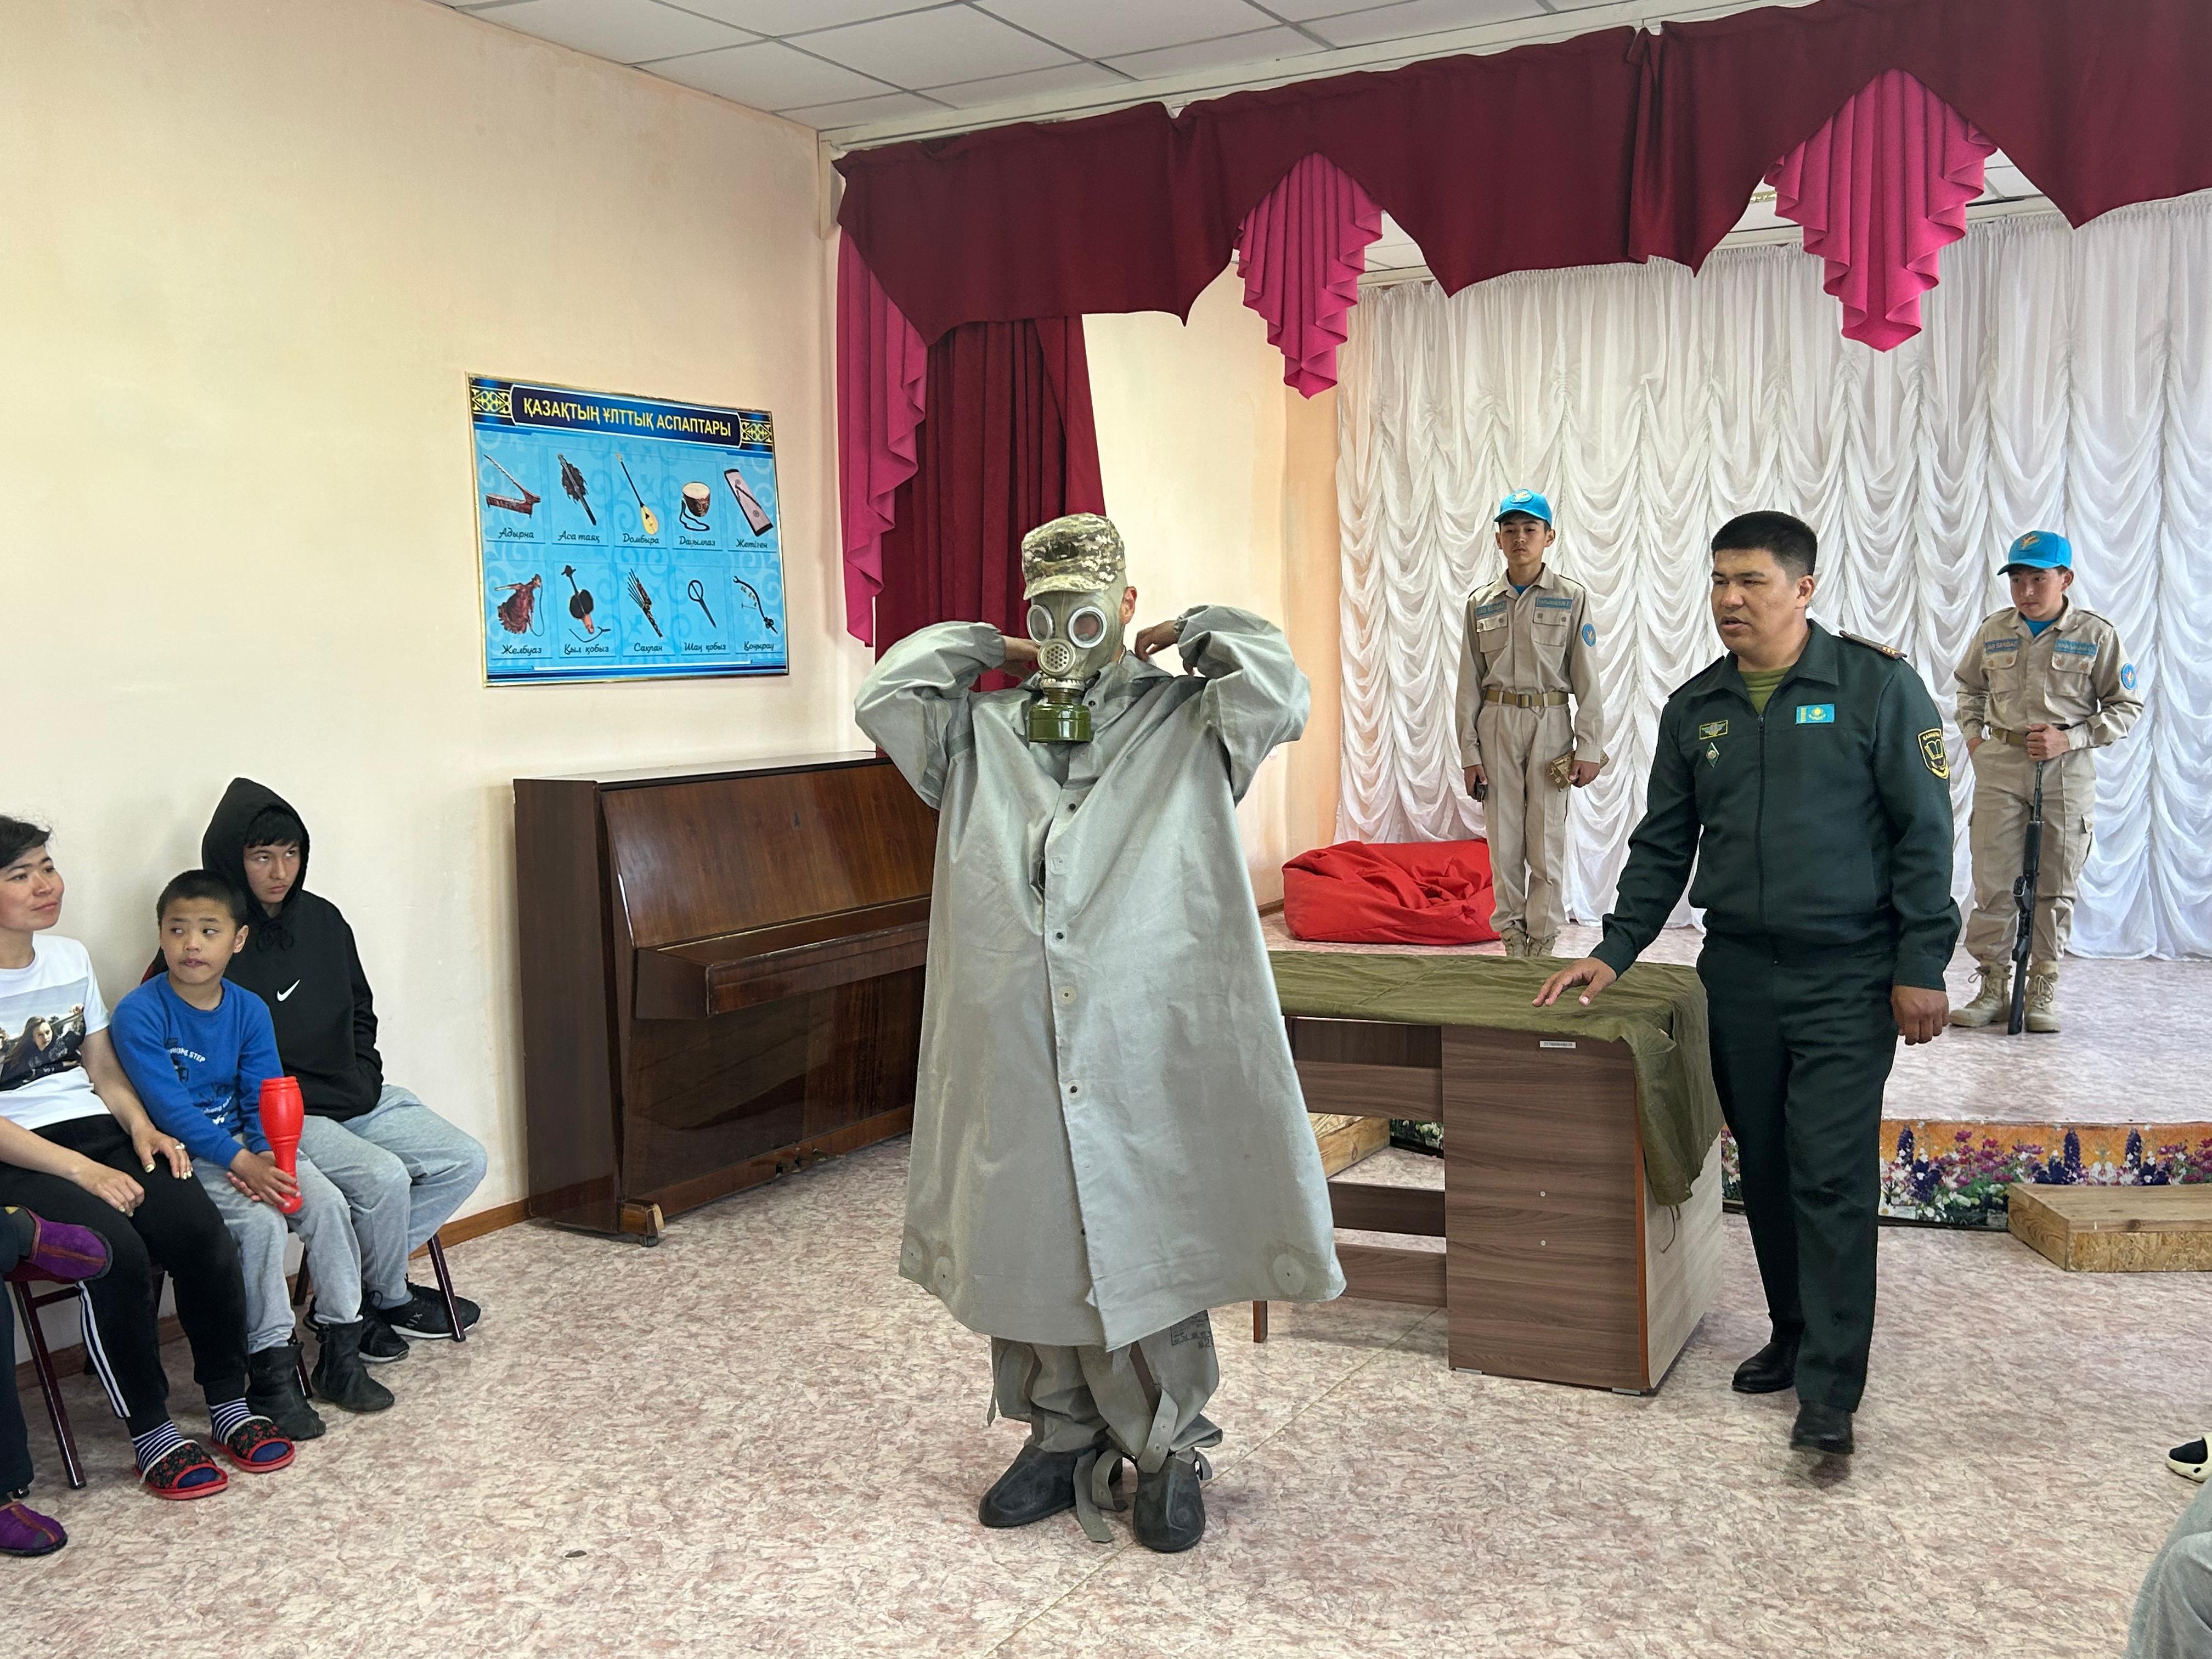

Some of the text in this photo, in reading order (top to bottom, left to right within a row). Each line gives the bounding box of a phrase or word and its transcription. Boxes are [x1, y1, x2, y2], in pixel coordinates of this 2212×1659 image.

[523, 398, 731, 437] ҚАЗАҚТЫҢ ҰЛТТЫҚ АСПАПТАРЫ
[498, 528, 534, 540] Адырна
[558, 531, 600, 543] Аса таяқ
[623, 533, 659, 545] Домбыра
[501, 645, 542, 657] Желбуаз
[585, 644, 609, 654] қобыз
[189, 1051, 206, 1063] STEP
